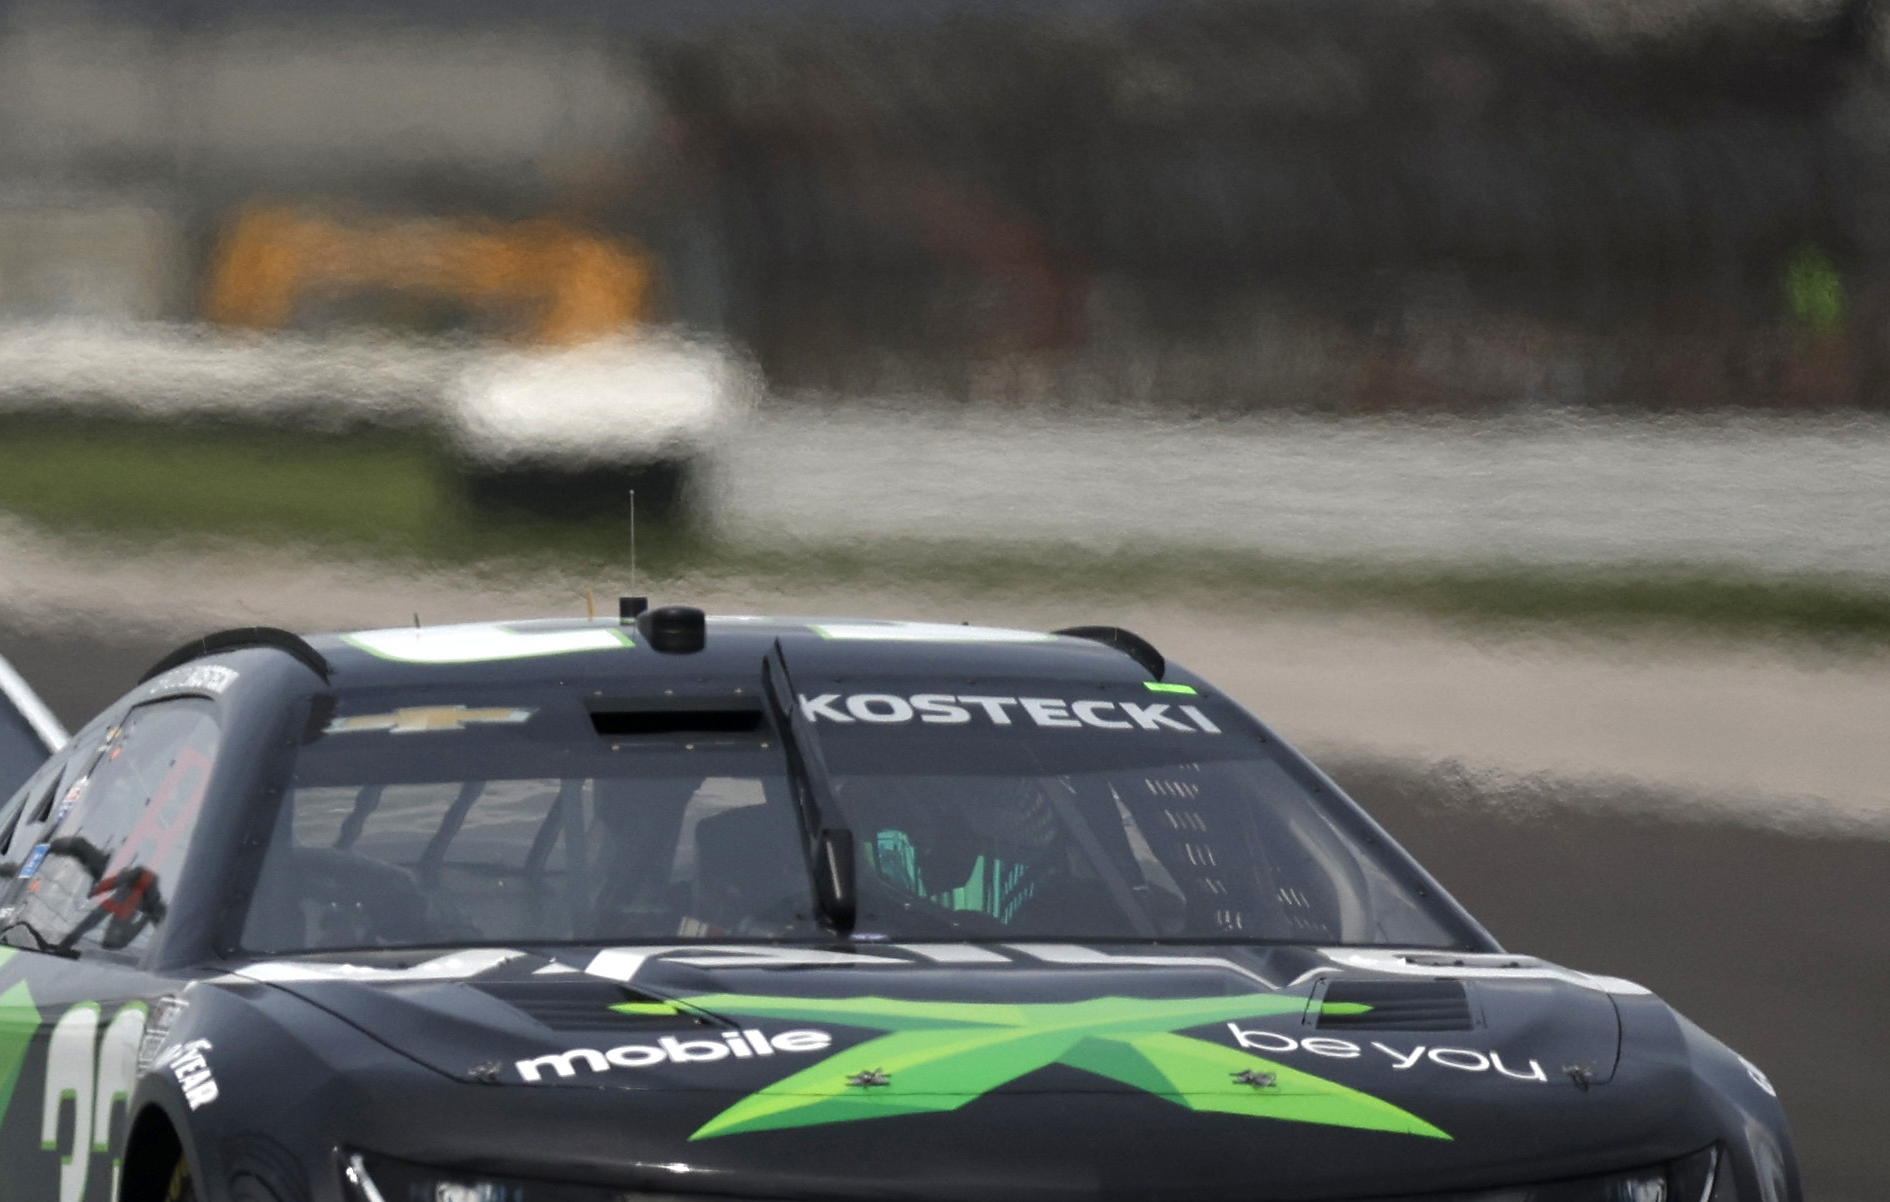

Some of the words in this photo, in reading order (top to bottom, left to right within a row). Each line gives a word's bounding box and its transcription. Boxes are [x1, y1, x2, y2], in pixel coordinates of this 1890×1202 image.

[798, 693, 1222, 734] KOSTECKI
[162, 1042, 219, 1112] YEAR
[515, 1028, 833, 1082] mobile
[1227, 1022, 1361, 1058] be
[1371, 1041, 1548, 1082] you
